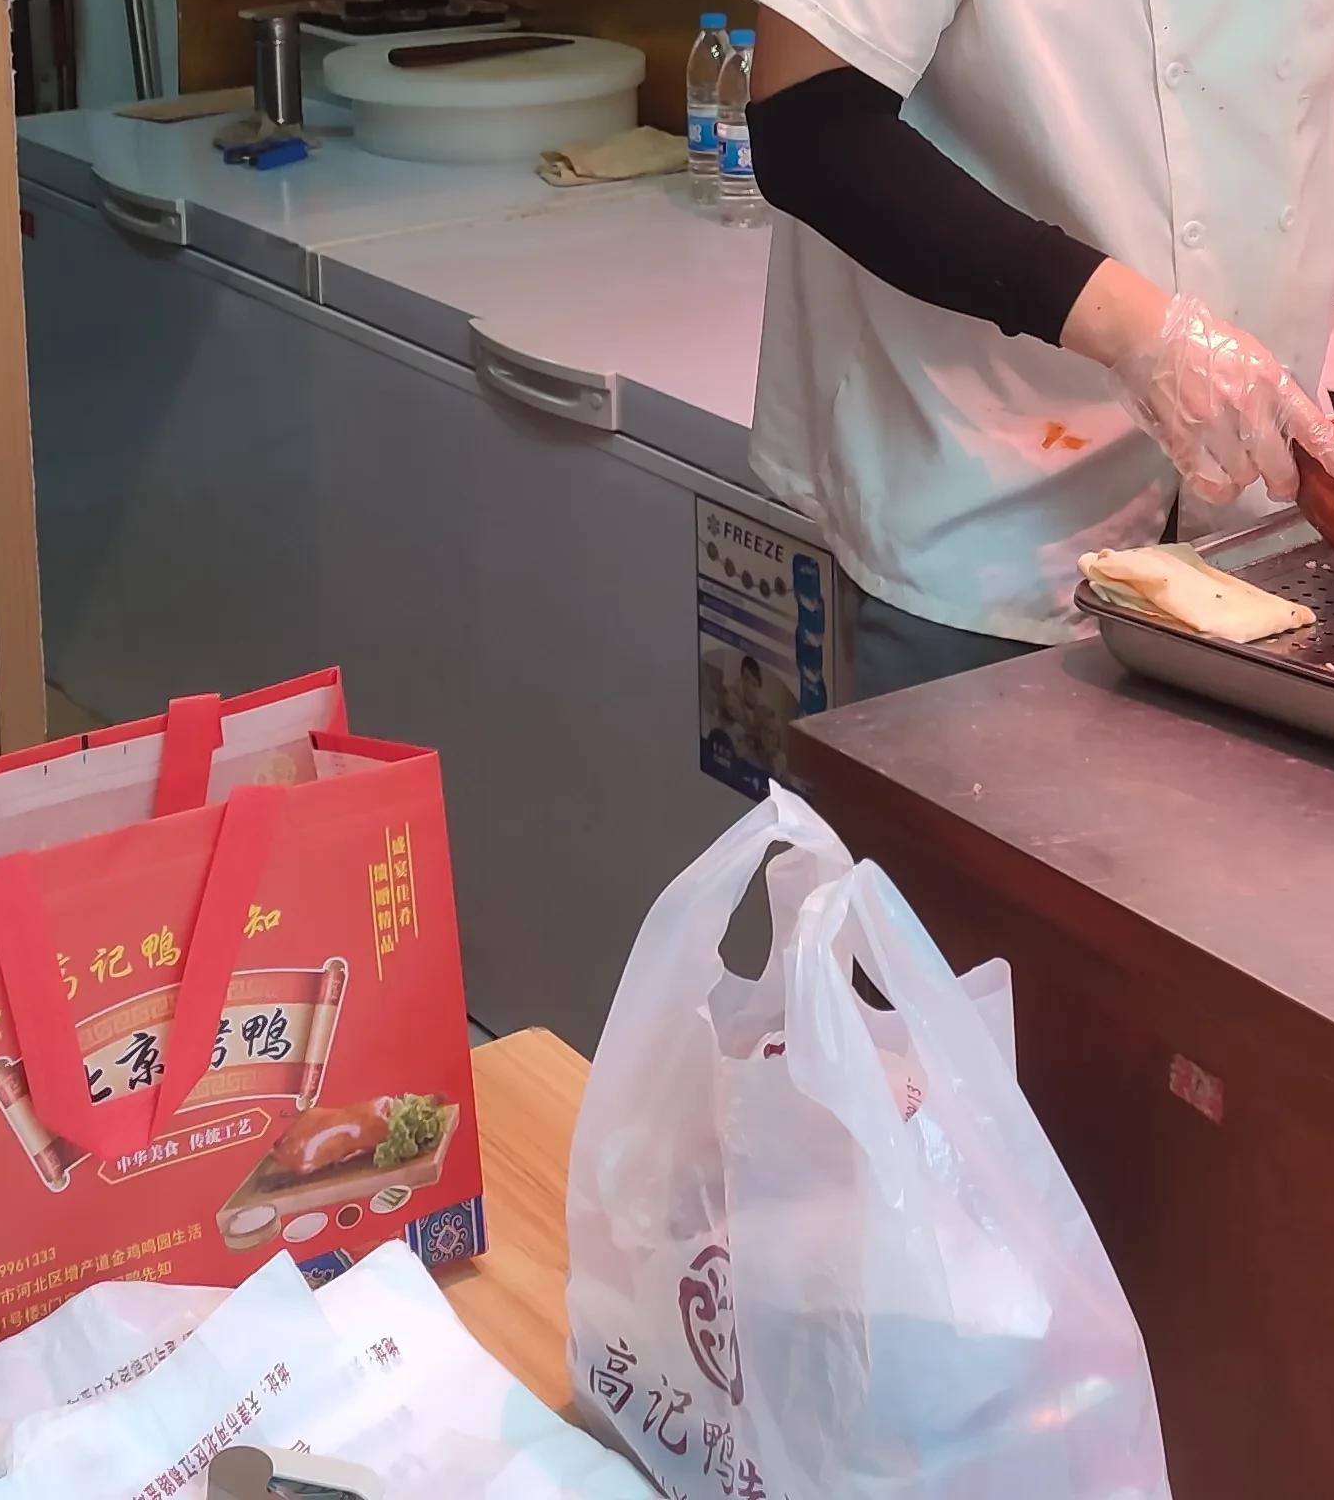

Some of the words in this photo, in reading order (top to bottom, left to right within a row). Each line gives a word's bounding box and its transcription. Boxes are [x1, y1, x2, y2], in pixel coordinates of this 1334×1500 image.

[723, 520, 786, 564] FREEZE
[116, 1138, 181, 1174] 中华美食
[189, 1117, 253, 1152] 传统工艺
